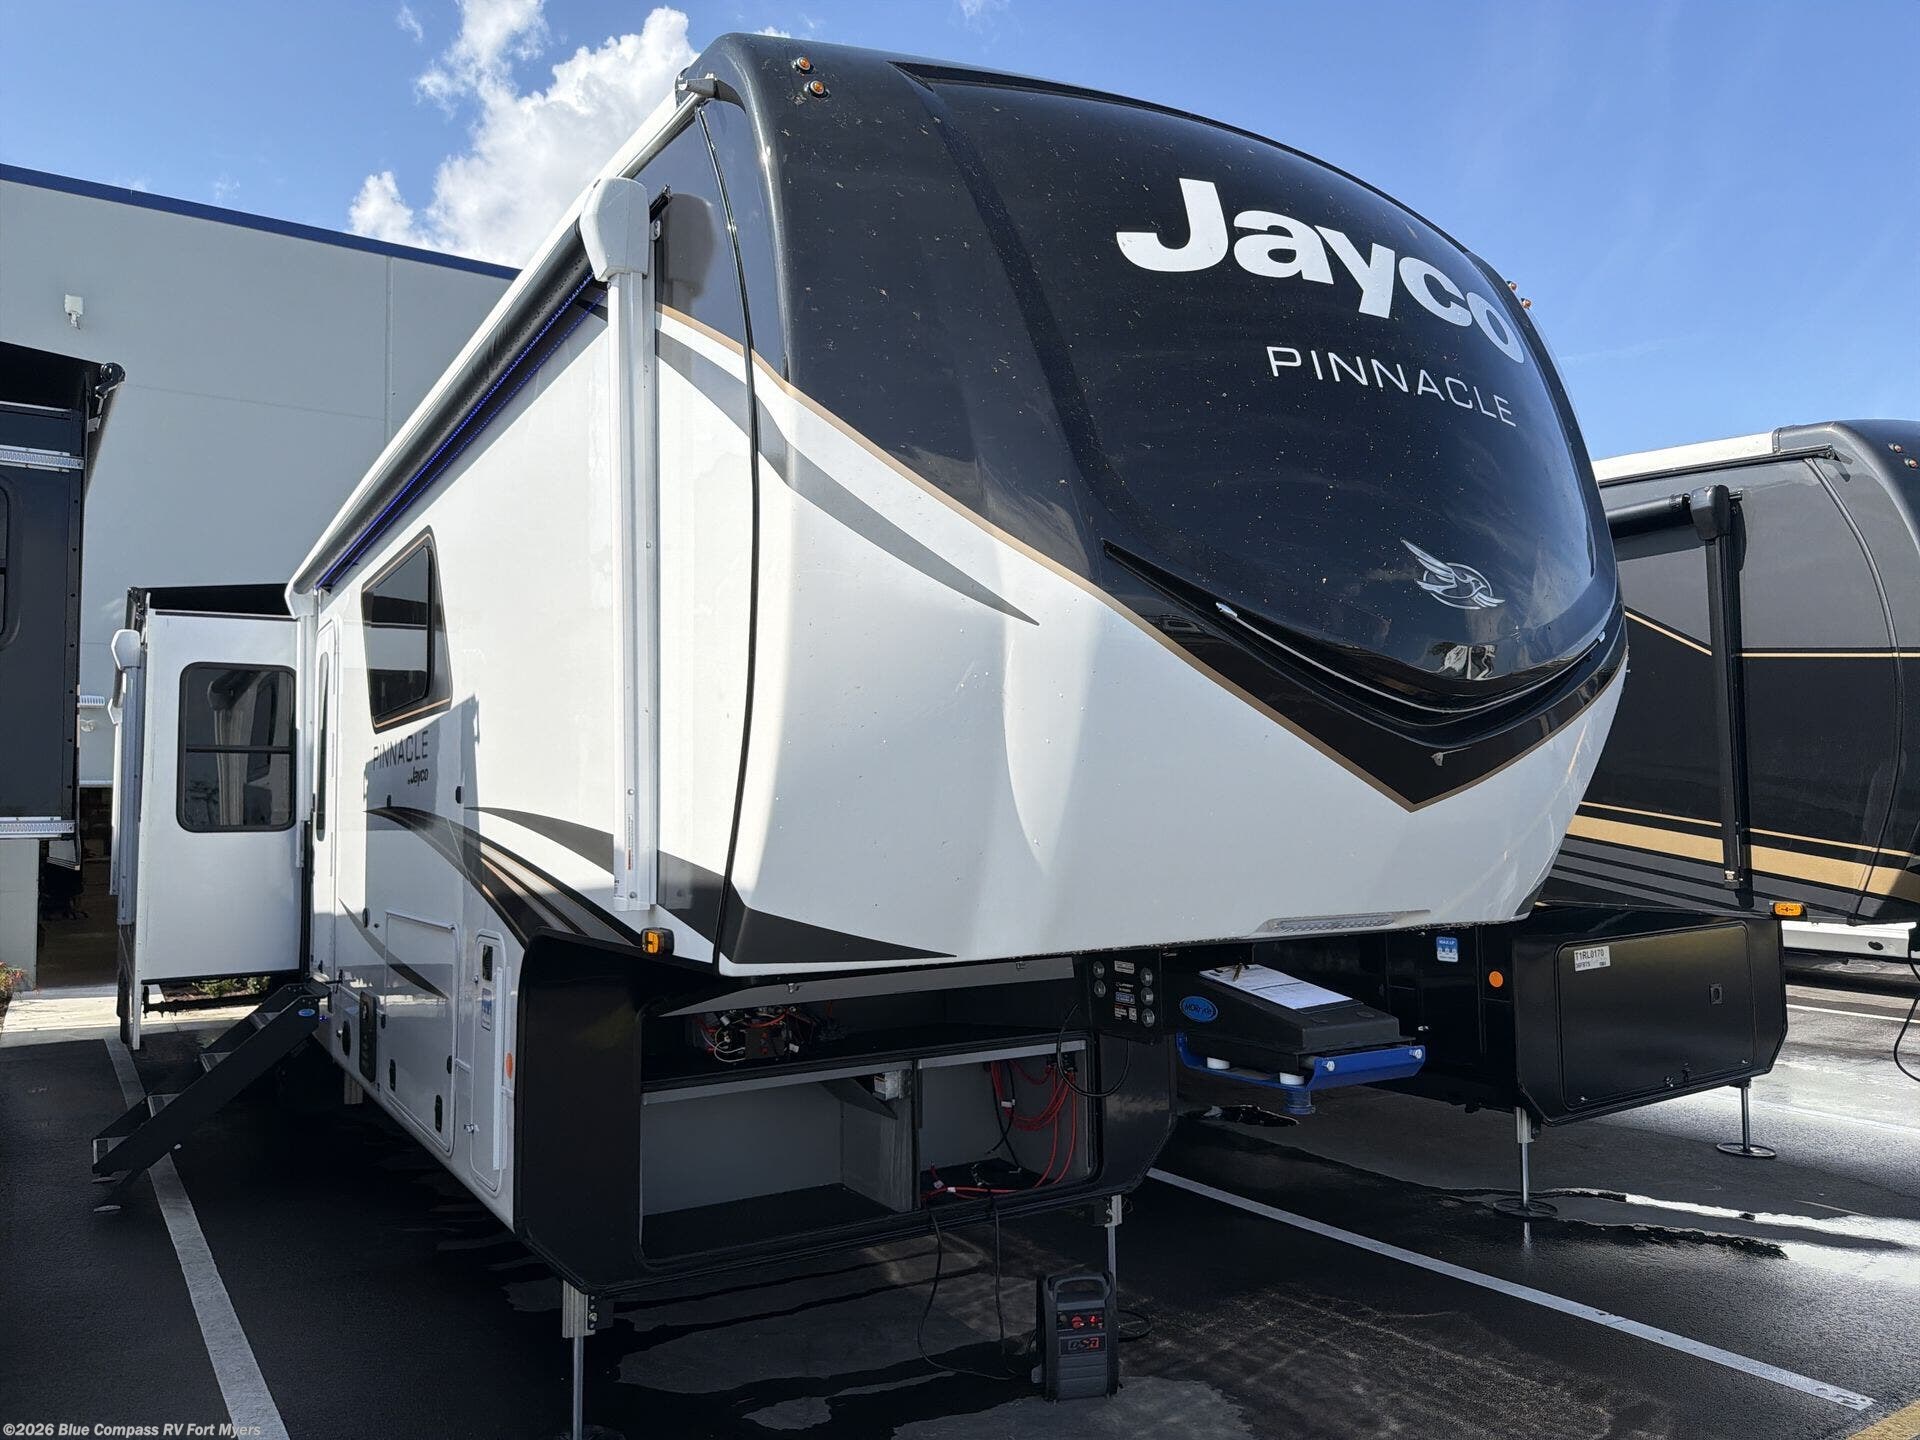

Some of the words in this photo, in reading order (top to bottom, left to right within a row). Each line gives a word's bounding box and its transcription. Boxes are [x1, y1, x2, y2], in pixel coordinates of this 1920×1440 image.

[1116, 178, 1525, 364] Jayco
[1266, 345, 1517, 428] PINNACLE
[373, 729, 429, 771] PINNACLE
